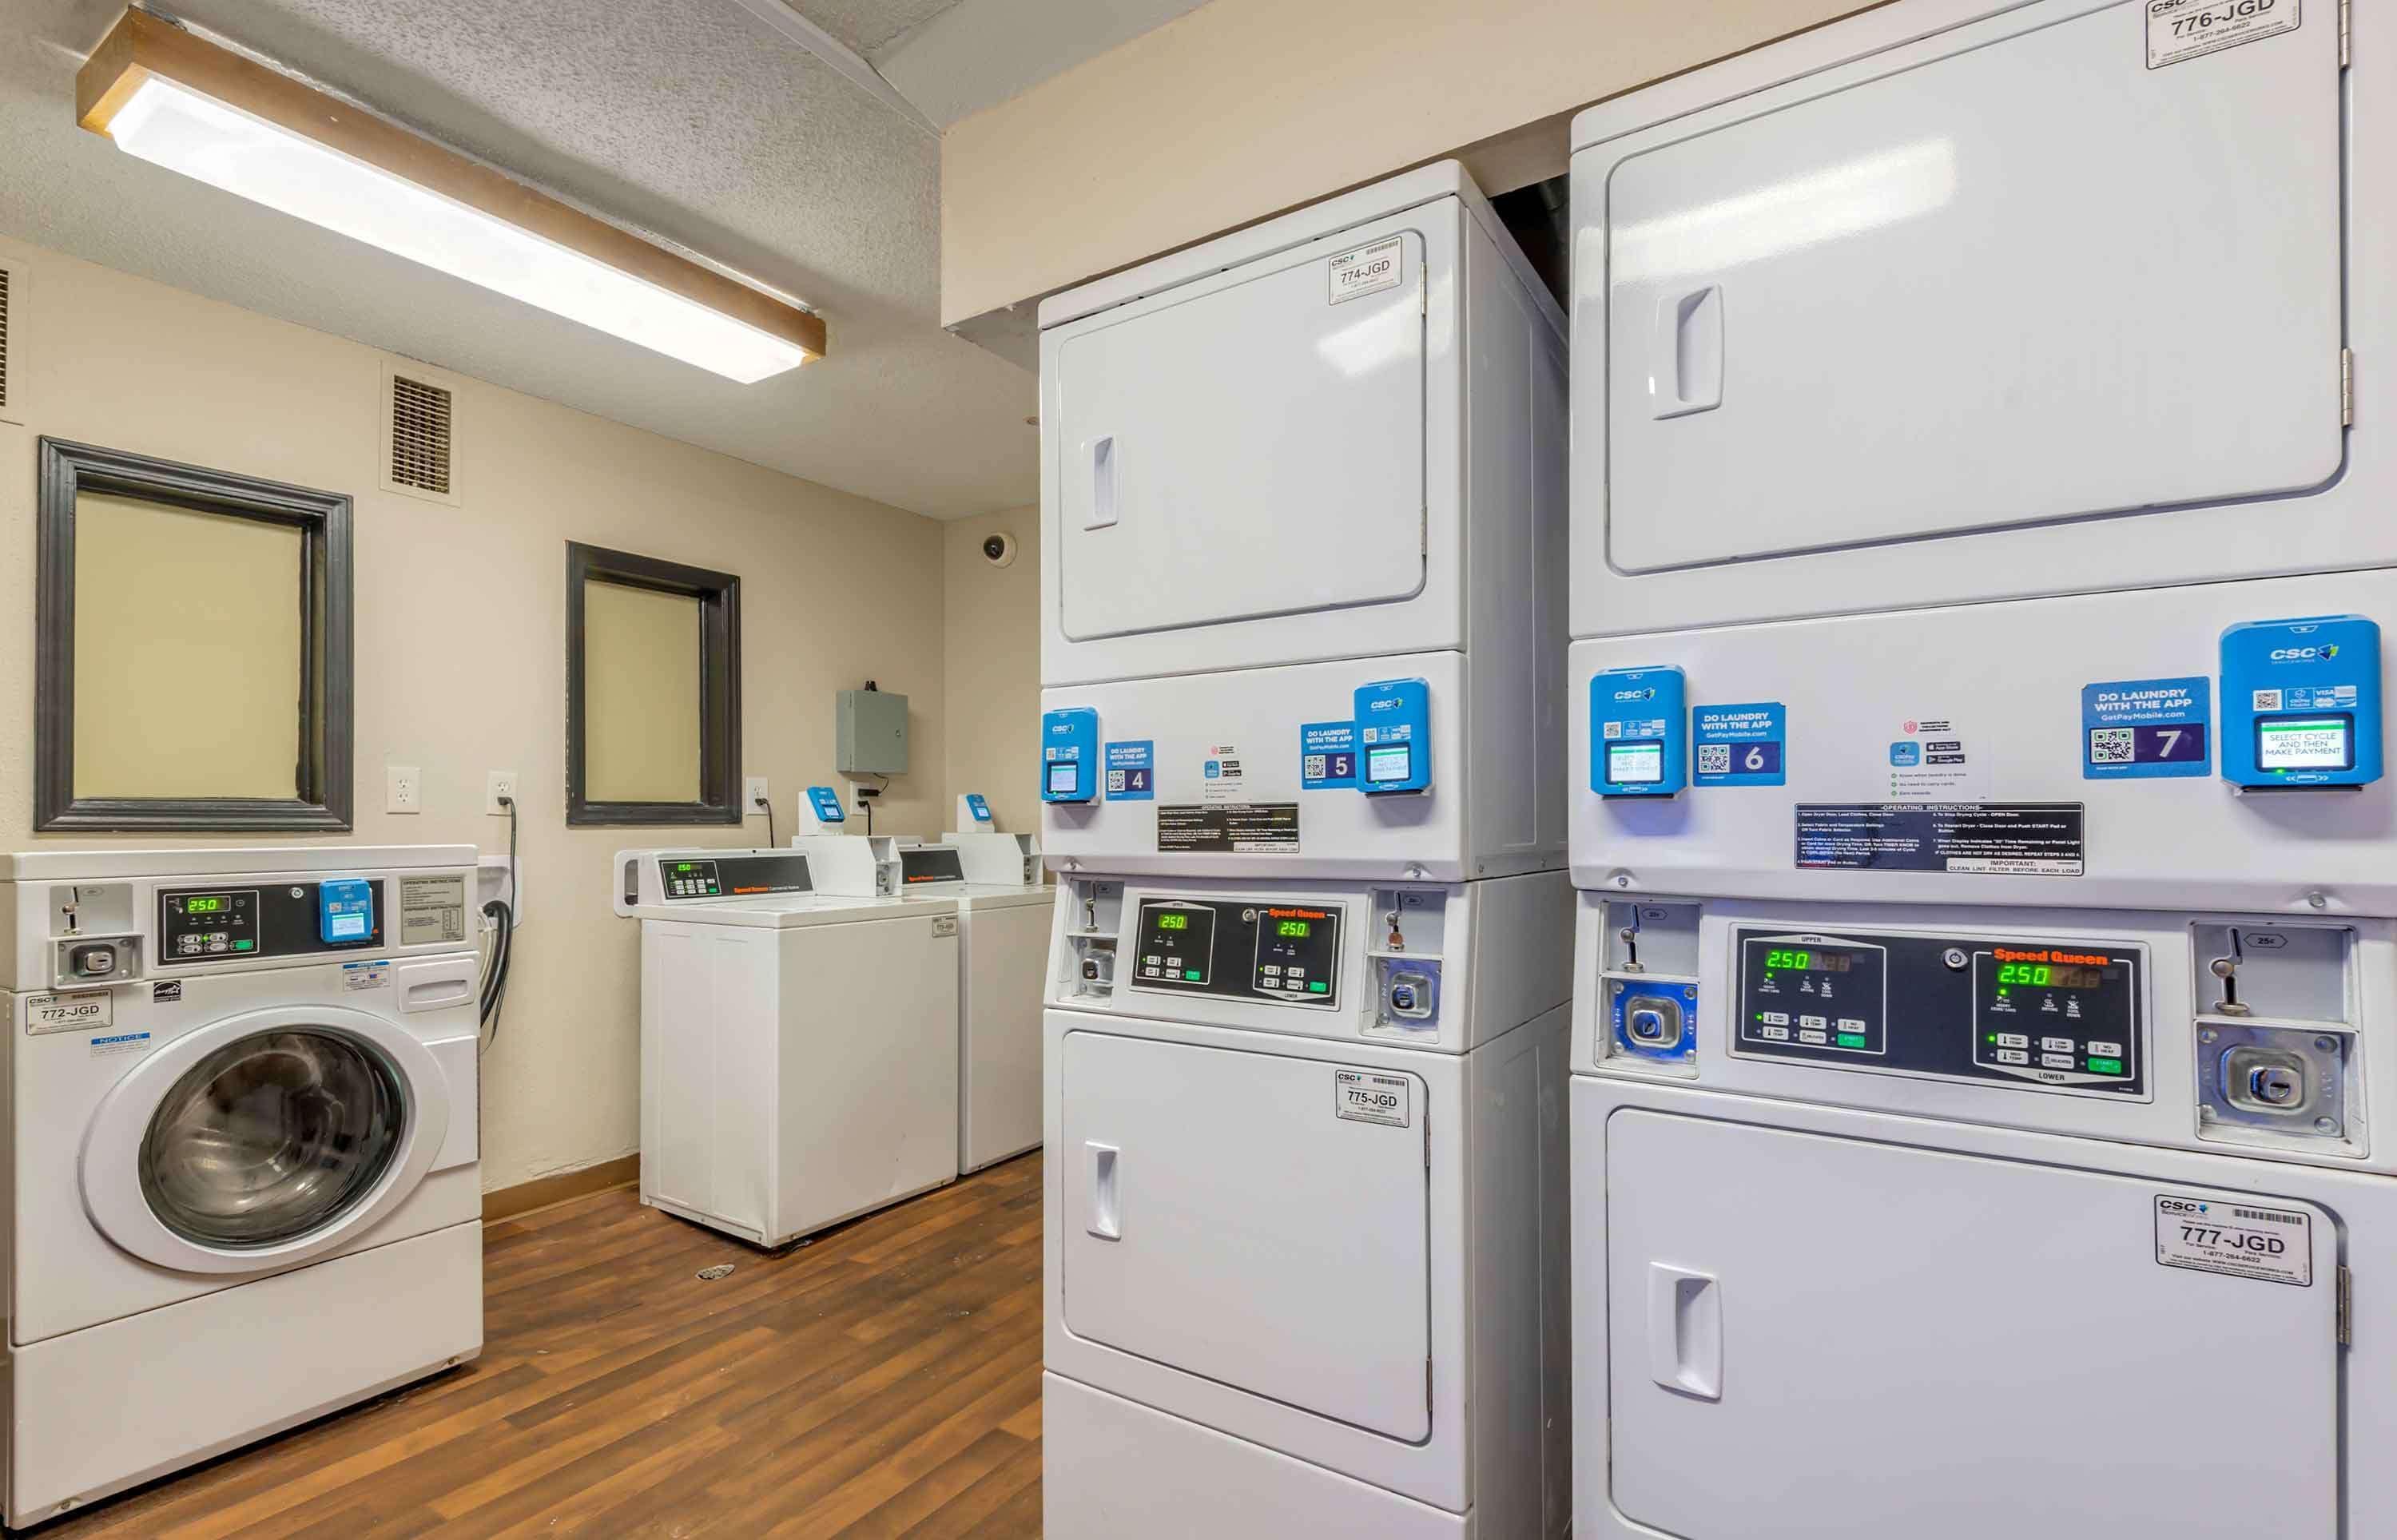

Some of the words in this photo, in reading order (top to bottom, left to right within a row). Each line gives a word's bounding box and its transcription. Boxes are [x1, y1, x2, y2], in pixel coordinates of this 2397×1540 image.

[2171, 0, 2275, 36] 776-JGD
[1331, 256, 1350, 267] CSC
[1341, 260, 1390, 284] 774-JGD
[2270, 647, 2316, 661] CSC
[1614, 690, 1642, 700] CSC
[2098, 693, 2118, 702] DO
[2121, 689, 2187, 701] LAUNDRY
[1370, 701, 1393, 709] CSC
[2094, 702, 2131, 712] WITH
[2134, 701, 2161, 709] THE
[2164, 698, 2192, 708] APP
[1721, 712, 1770, 721] LAUNDRY
[2101, 711, 2185, 721] GetPayMobile.com
[1701, 722, 1728, 731] WITH
[1730, 721, 1750, 730] THE
[1751, 720, 1772, 729] APP
[1706, 730, 1767, 739] GetPayMobile.com
[2304, 732, 2337, 740] CYCLE
[2156, 730, 2182, 758] 7
[1744, 746, 1764, 770] 6
[1335, 756, 1348, 775] 5
[1132, 772, 1144, 788] 4
[1269, 908, 1296, 918] Speed
[1297, 909, 1326, 919] Queen
[1766, 951, 1811, 970] 2.50
[1994, 948, 2048, 963] Speed
[2050, 951, 2109, 966] Queen
[2000, 965, 2049, 986] 2.50
[42, 1006, 100, 1019] 772-JGD
[100, 1033, 141, 1043] NOTICE
[1348, 1090, 1397, 1106] 775-JGD
[2160, 1201, 2196, 1212] CSC
[2180, 1226, 2285, 1254] 777-JGD
